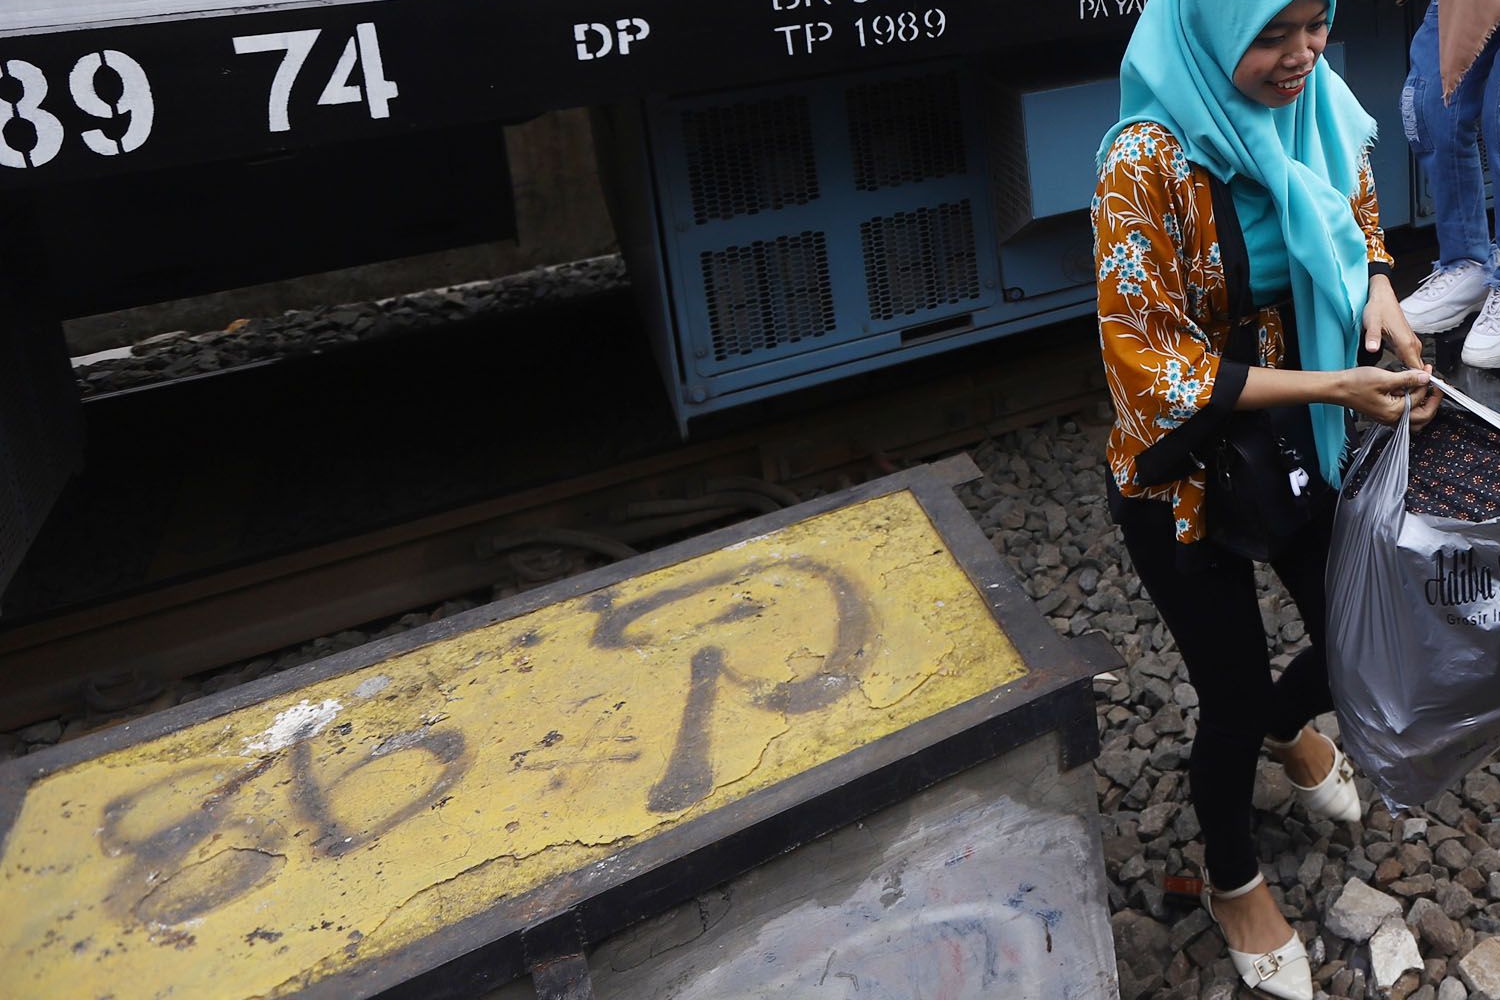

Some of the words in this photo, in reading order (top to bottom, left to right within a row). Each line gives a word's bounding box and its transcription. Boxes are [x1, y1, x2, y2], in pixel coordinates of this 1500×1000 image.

[774, 22, 832, 55] TP
[854, 8, 946, 47] 1989
[232, 22, 398, 132] 74
[574, 17, 650, 61] DP
[1446, 612, 1488, 627] Grosir
